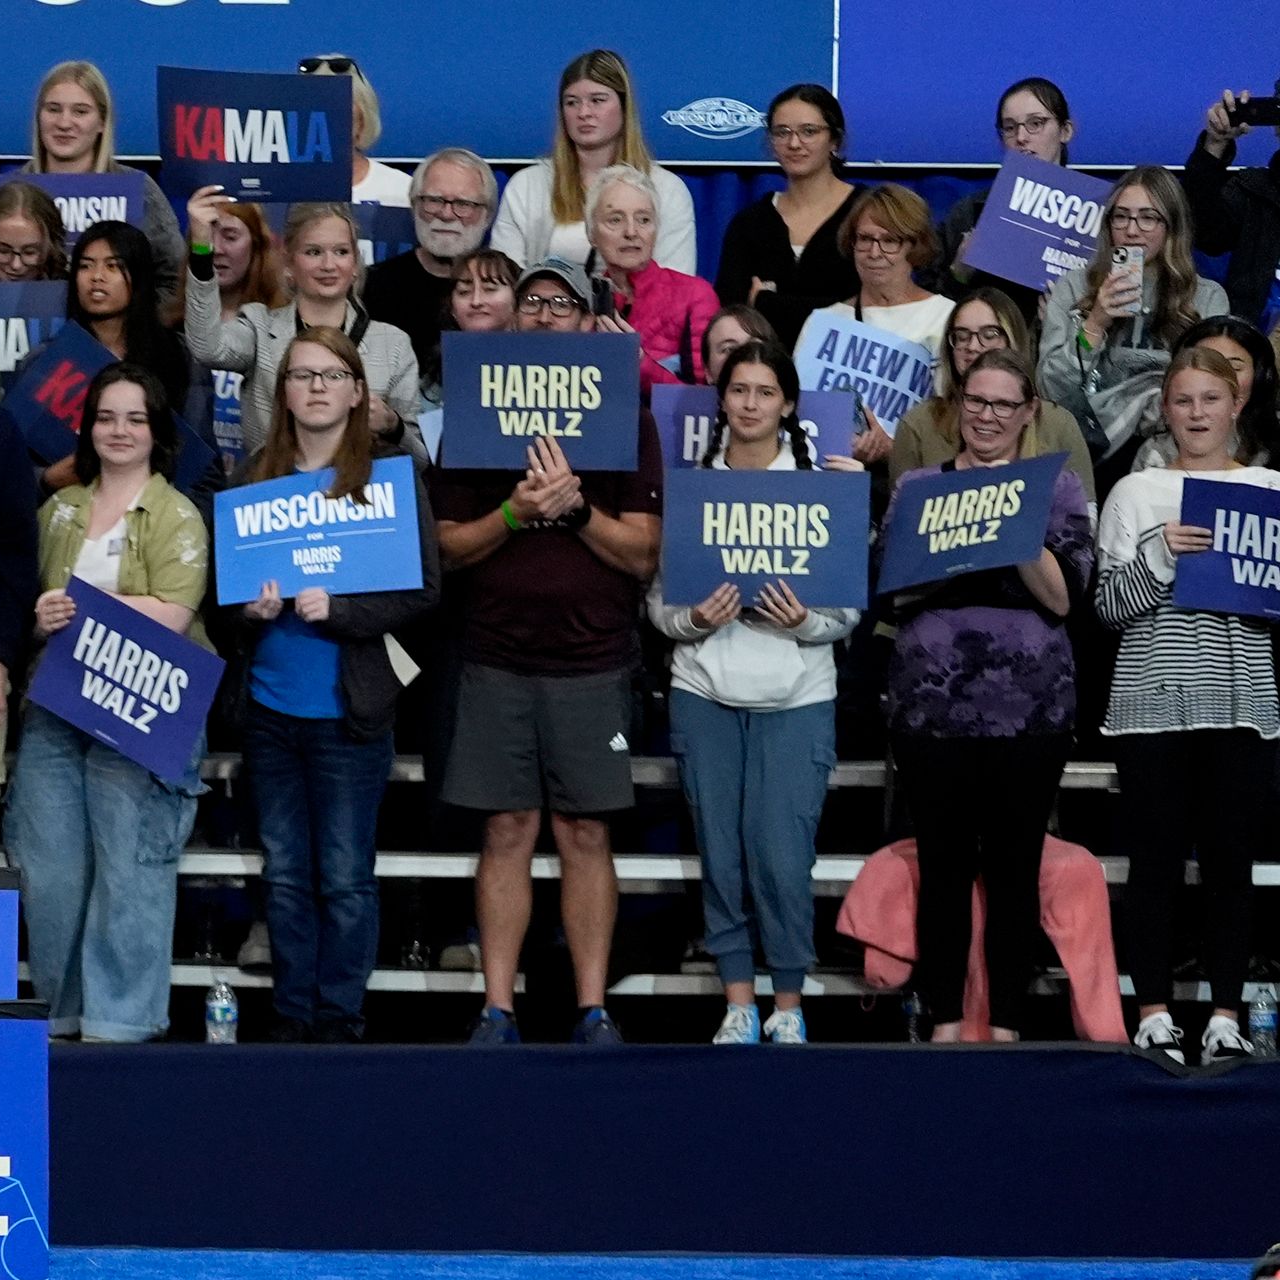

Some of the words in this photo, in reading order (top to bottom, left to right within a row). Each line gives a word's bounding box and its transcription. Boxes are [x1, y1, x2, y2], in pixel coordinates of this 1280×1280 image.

[174, 104, 333, 163] KAMALA
[54, 195, 128, 233] ONSIN
[816, 328, 841, 363] A
[841, 334, 910, 383] NEW
[480, 364, 602, 410] HARRIS
[497, 410, 582, 438] WALZ
[703, 502, 830, 549] HARRIS
[917, 479, 1026, 536] HARRIS
[293, 545, 341, 566] HARRIS
[306, 533, 324, 541] FOR
[929, 519, 1001, 554] WALZ
[301, 563, 336, 575] WALZ
[721, 549, 809, 575] WALZ
[73, 616, 189, 714] HARRIS
[81, 669, 159, 734] WALZ
